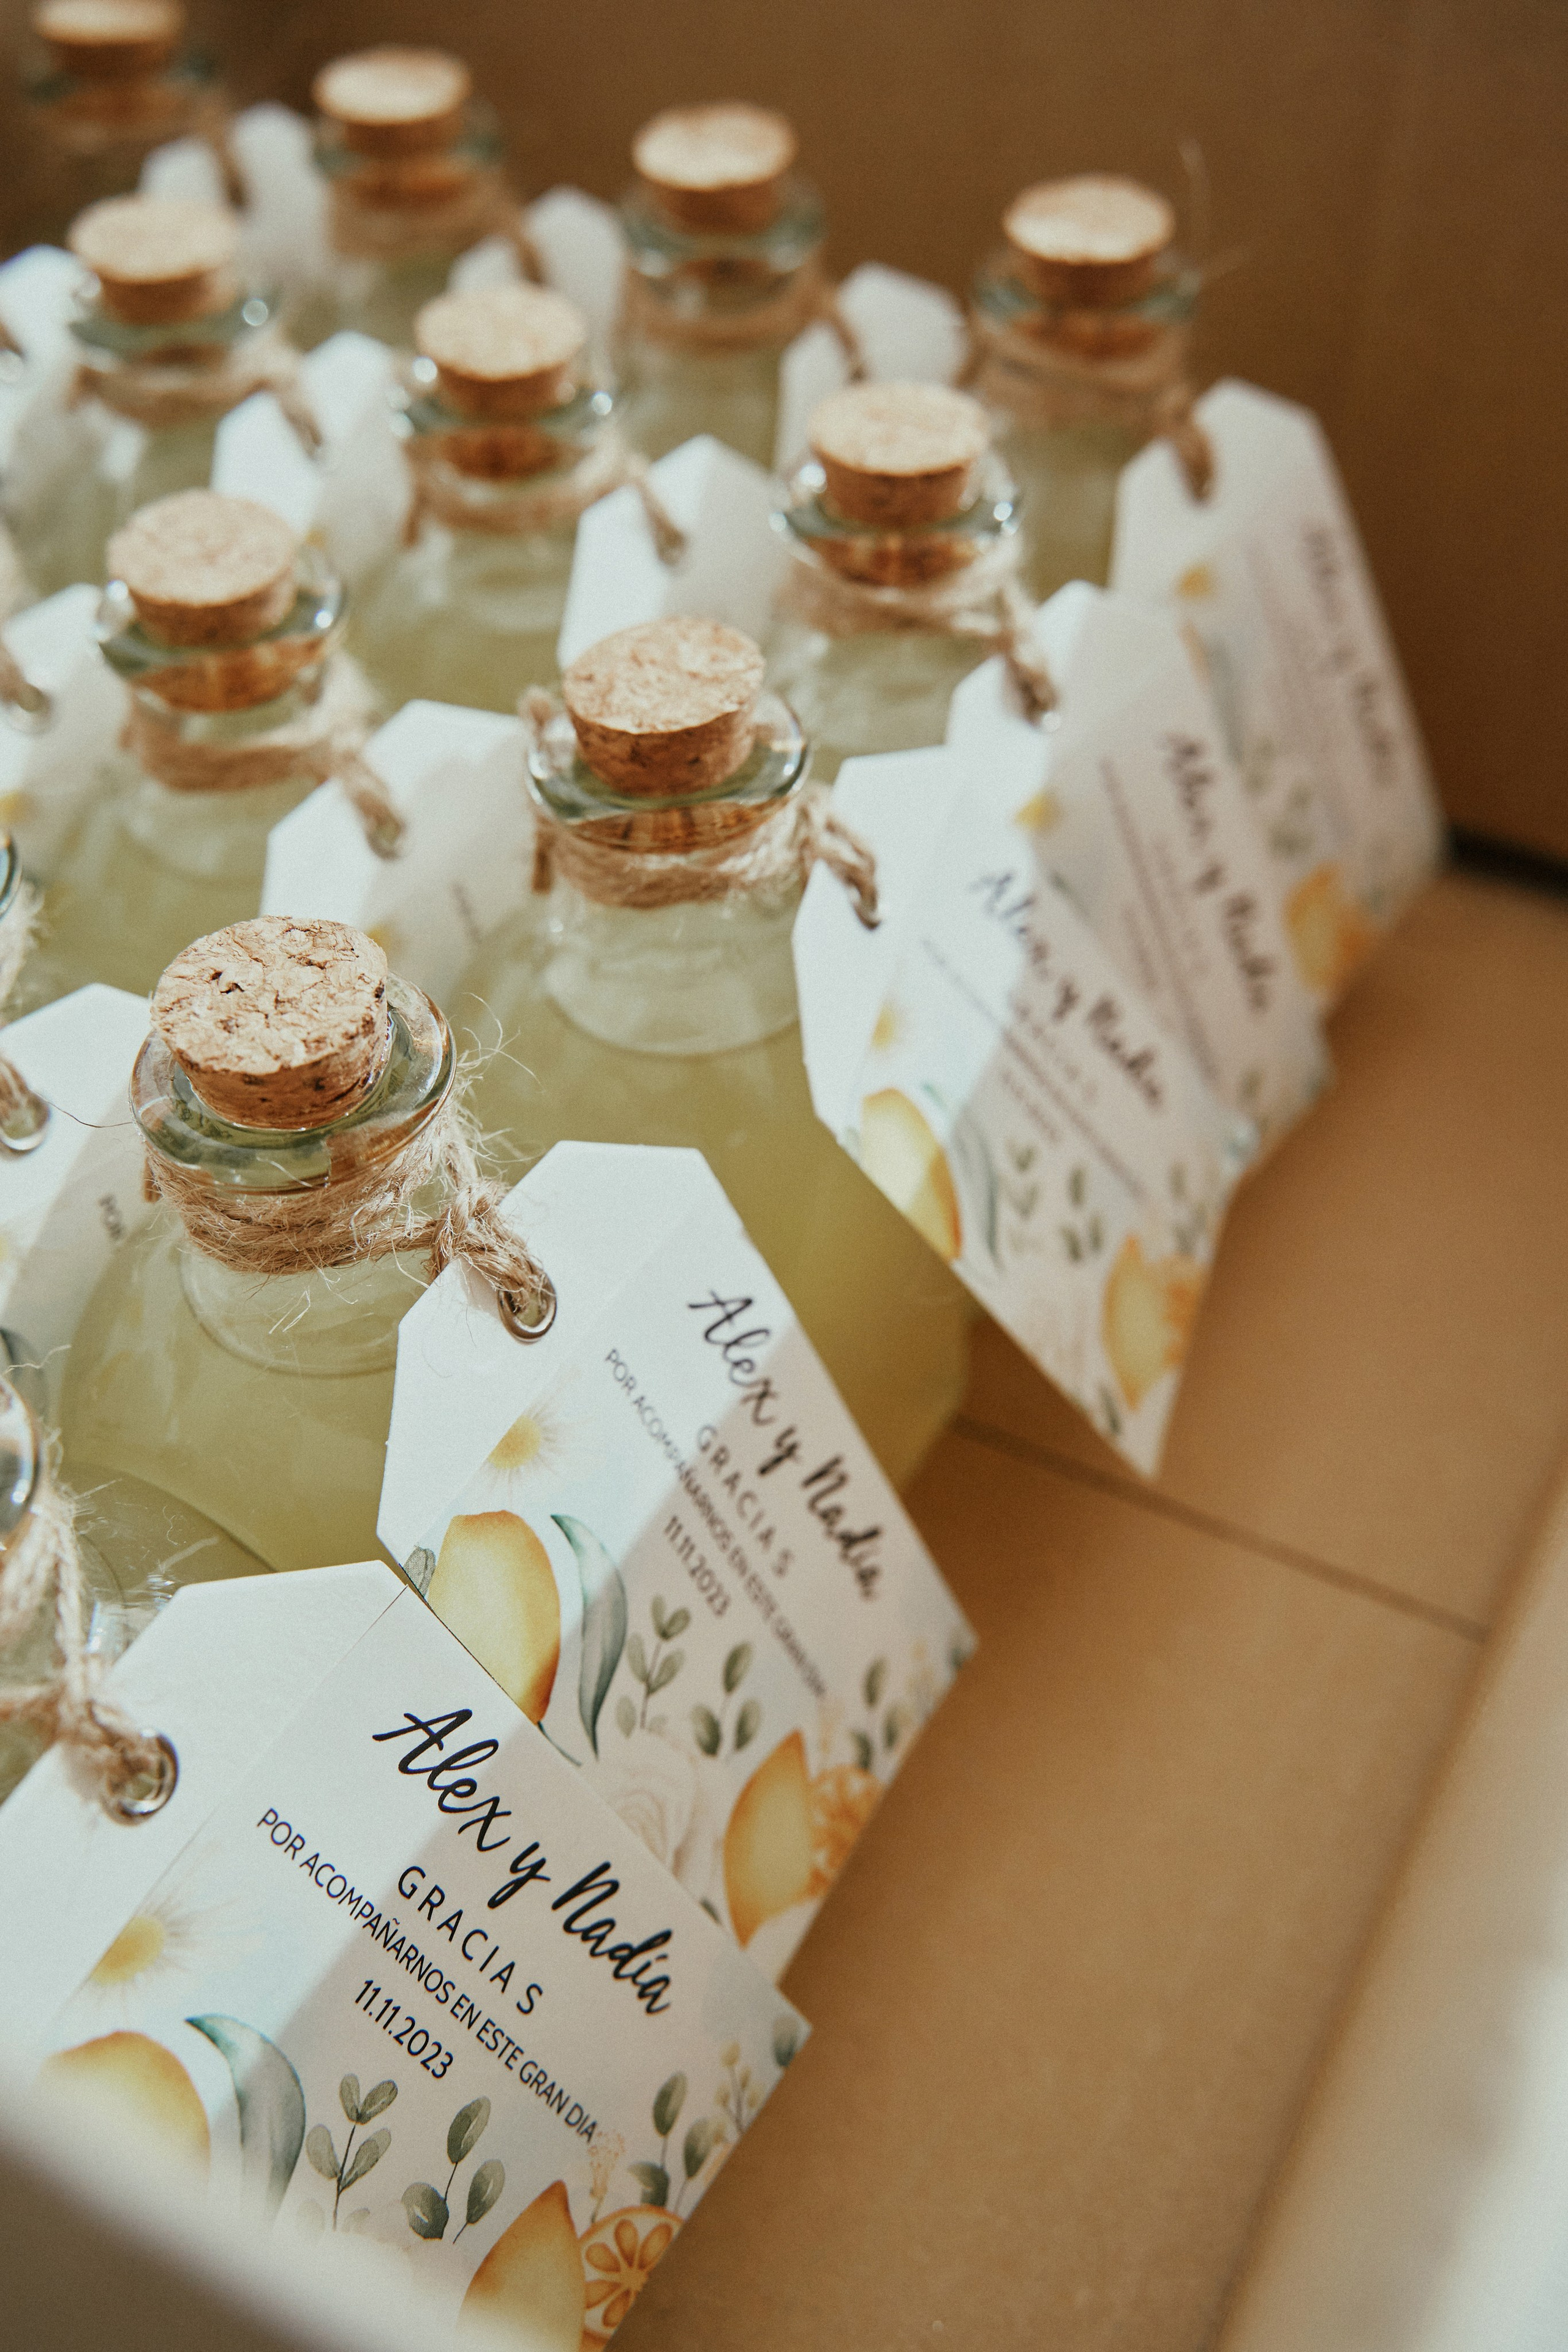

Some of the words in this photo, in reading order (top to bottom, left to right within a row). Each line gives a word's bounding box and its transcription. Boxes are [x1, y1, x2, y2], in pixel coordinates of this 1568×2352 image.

[605, 1348, 637, 1396] POR
[688, 1289, 778, 1425] Alex
[756, 1425, 802, 1477] y
[696, 1423, 794, 1579] GRACIAS
[372, 1708, 511, 1852] Alex
[488, 1841, 551, 1909] y
[256, 1807, 306, 1861] POR
[299, 1852, 456, 2005] ACOMPAÑARNOS
[450, 1992, 482, 2031] EN
[476, 2018, 524, 2071] ESTE
[519, 2059, 570, 2115] GRAN
[564, 2101, 598, 2144] DIA
[398, 1865, 543, 2015] GRACIAS
[354, 1979, 454, 2079] 11.11.2023
